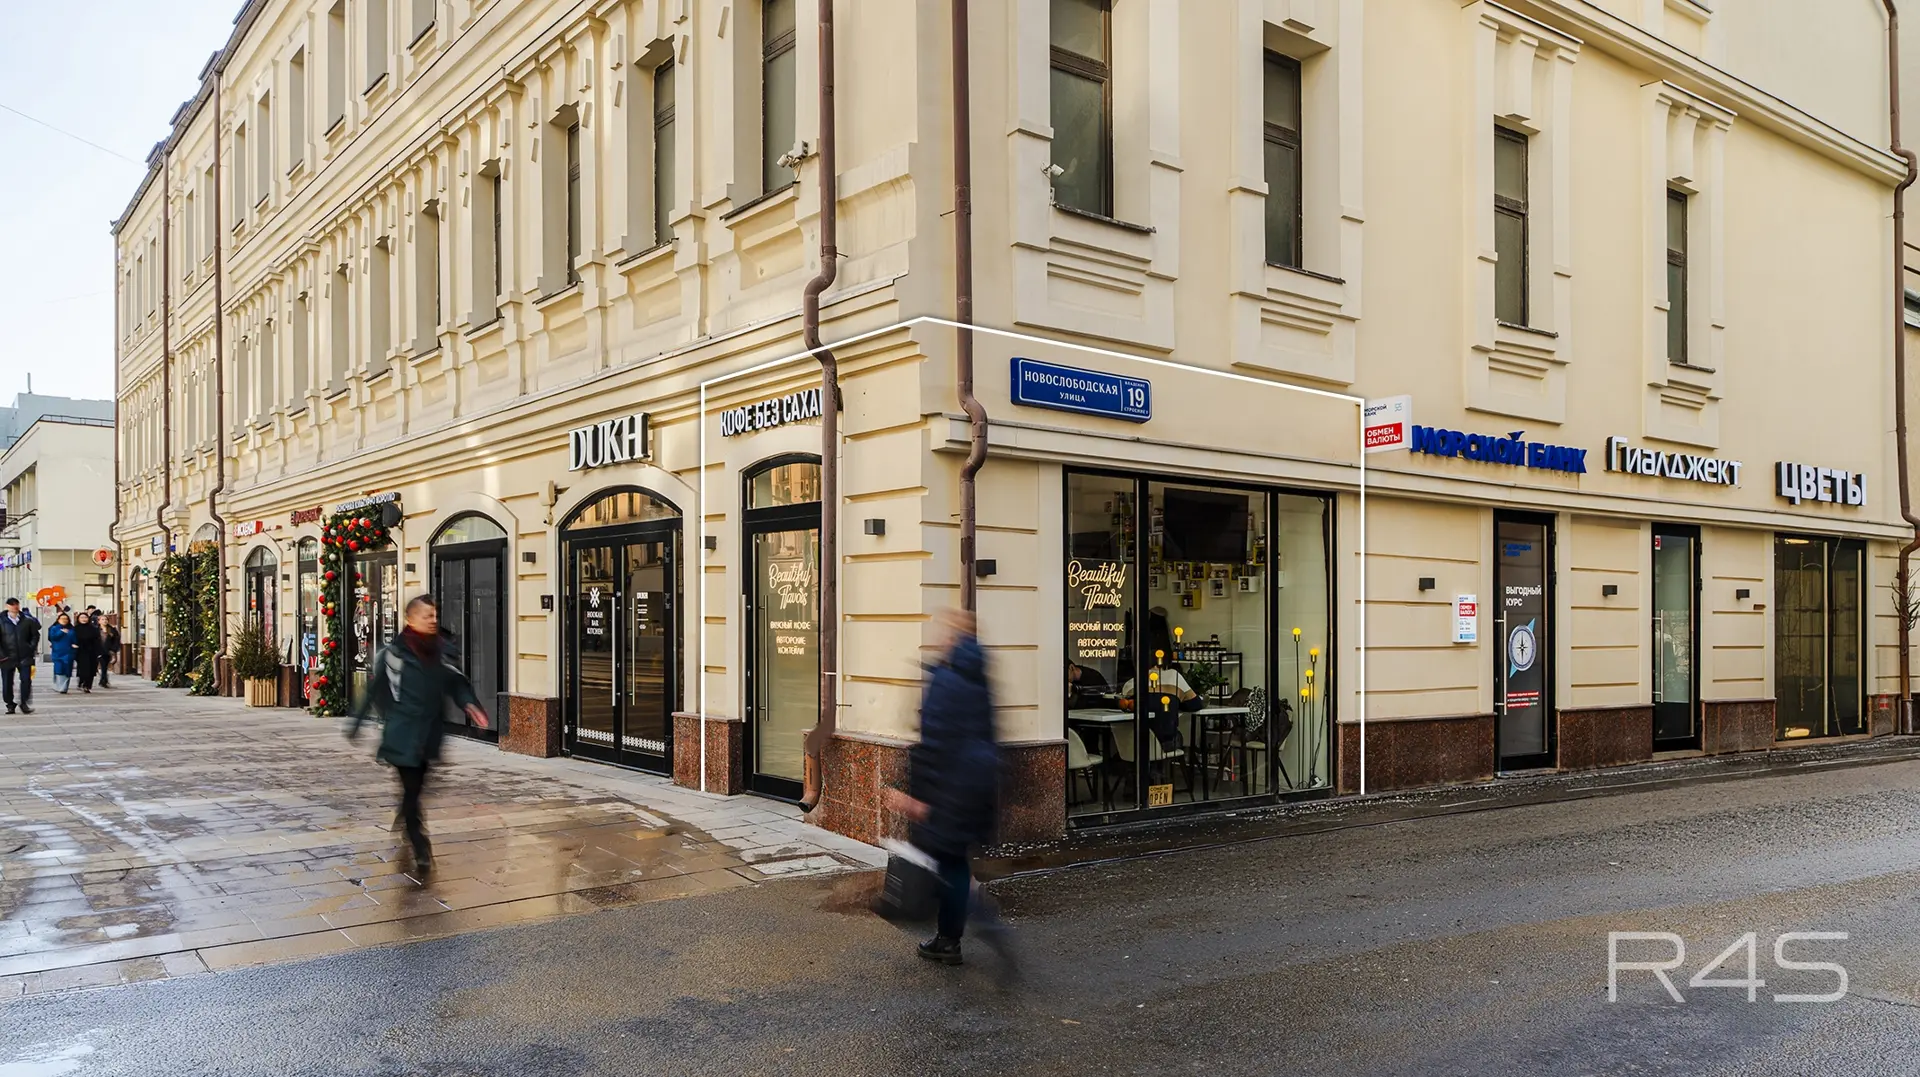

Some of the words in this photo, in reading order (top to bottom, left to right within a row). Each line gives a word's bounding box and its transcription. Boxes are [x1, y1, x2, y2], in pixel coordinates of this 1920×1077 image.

[1024, 370, 1118, 395] НОВОСЛОБОДСКАЯ
[1059, 391, 1086, 403] УЛИЦА
[1127, 387, 1145, 408] 19
[720, 405, 753, 437] КОФЕ
[755, 397, 780, 430] БЕЗ
[1367, 427, 1394, 438] ОБМЕН
[568, 412, 648, 472] DUKH
[1367, 433, 1401, 445] ВАЛЮТЫ
[1411, 425, 1526, 466] МОРСКОЙ
[1528, 442, 1588, 474] БАНК
[1777, 461, 1867, 506] ЦВЕТЫ
[768, 563, 812, 589] Beautiful
[1068, 560, 1127, 589] Beautiful
[1505, 585, 1542, 597] ВЫГОДНЫЙ
[1505, 598, 1523, 607] КУРС
[770, 620, 793, 630] ВКУСНЫЙ
[793, 621, 811, 630] КОФЕ
[1069, 621, 1101, 632] ВКУСНЫЙ
[1103, 623, 1125, 632] КОФЕ
[775, 636, 807, 645] АВТОРСКИЕ
[1077, 638, 1118, 647] АВТОРСКИЕ
[777, 645, 805, 655] КОКТЕЙЛИ
[1079, 648, 1116, 658] КОКТЕЙЛИ
